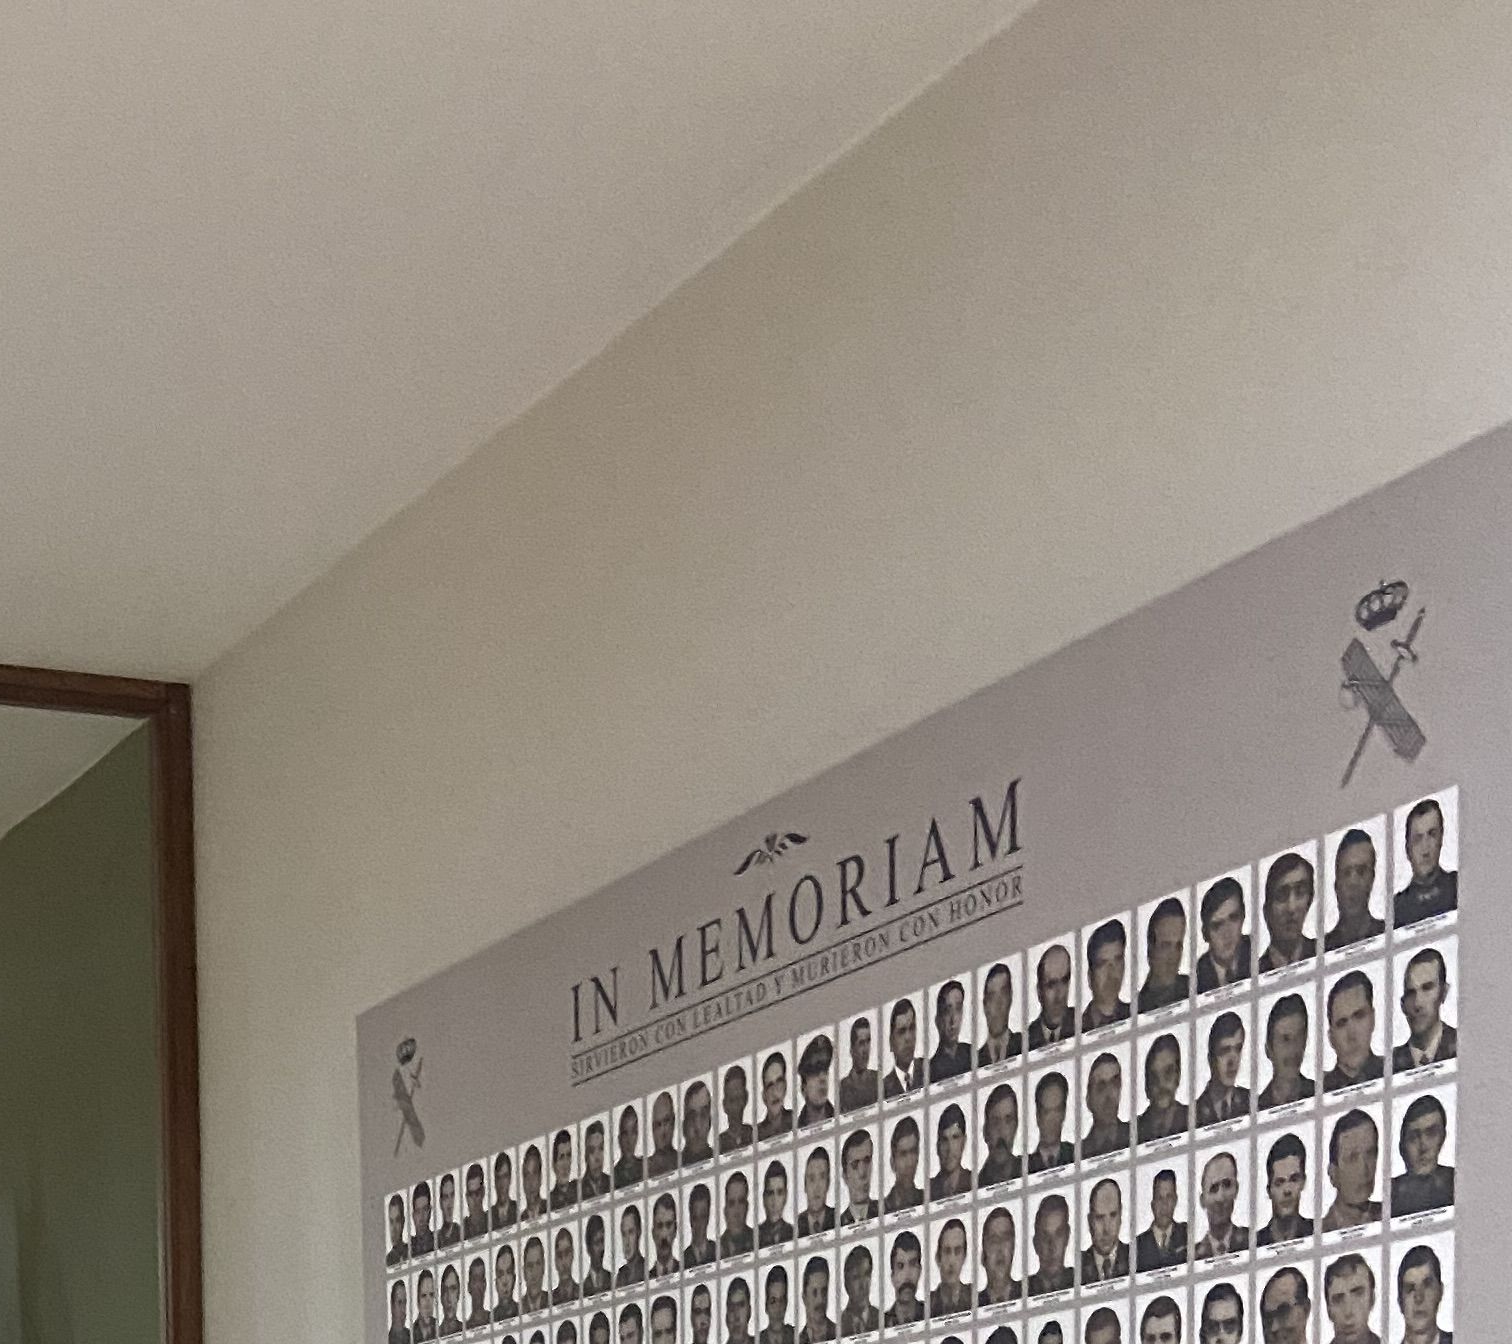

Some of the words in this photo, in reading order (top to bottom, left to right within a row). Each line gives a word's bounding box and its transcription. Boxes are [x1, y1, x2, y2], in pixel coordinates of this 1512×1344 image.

[570, 965, 619, 1043] IN
[648, 776, 1024, 1012] MEMORIAM
[570, 1032, 648, 1079] SIRVIERON
[653, 1016, 687, 1045] CON
[692, 981, 768, 1030] LEALTAD
[771, 973, 787, 1003] Y
[789, 931, 891, 987] MURIERON
[898, 908, 942, 944] CON
[947, 873, 1023, 923] HONOR
